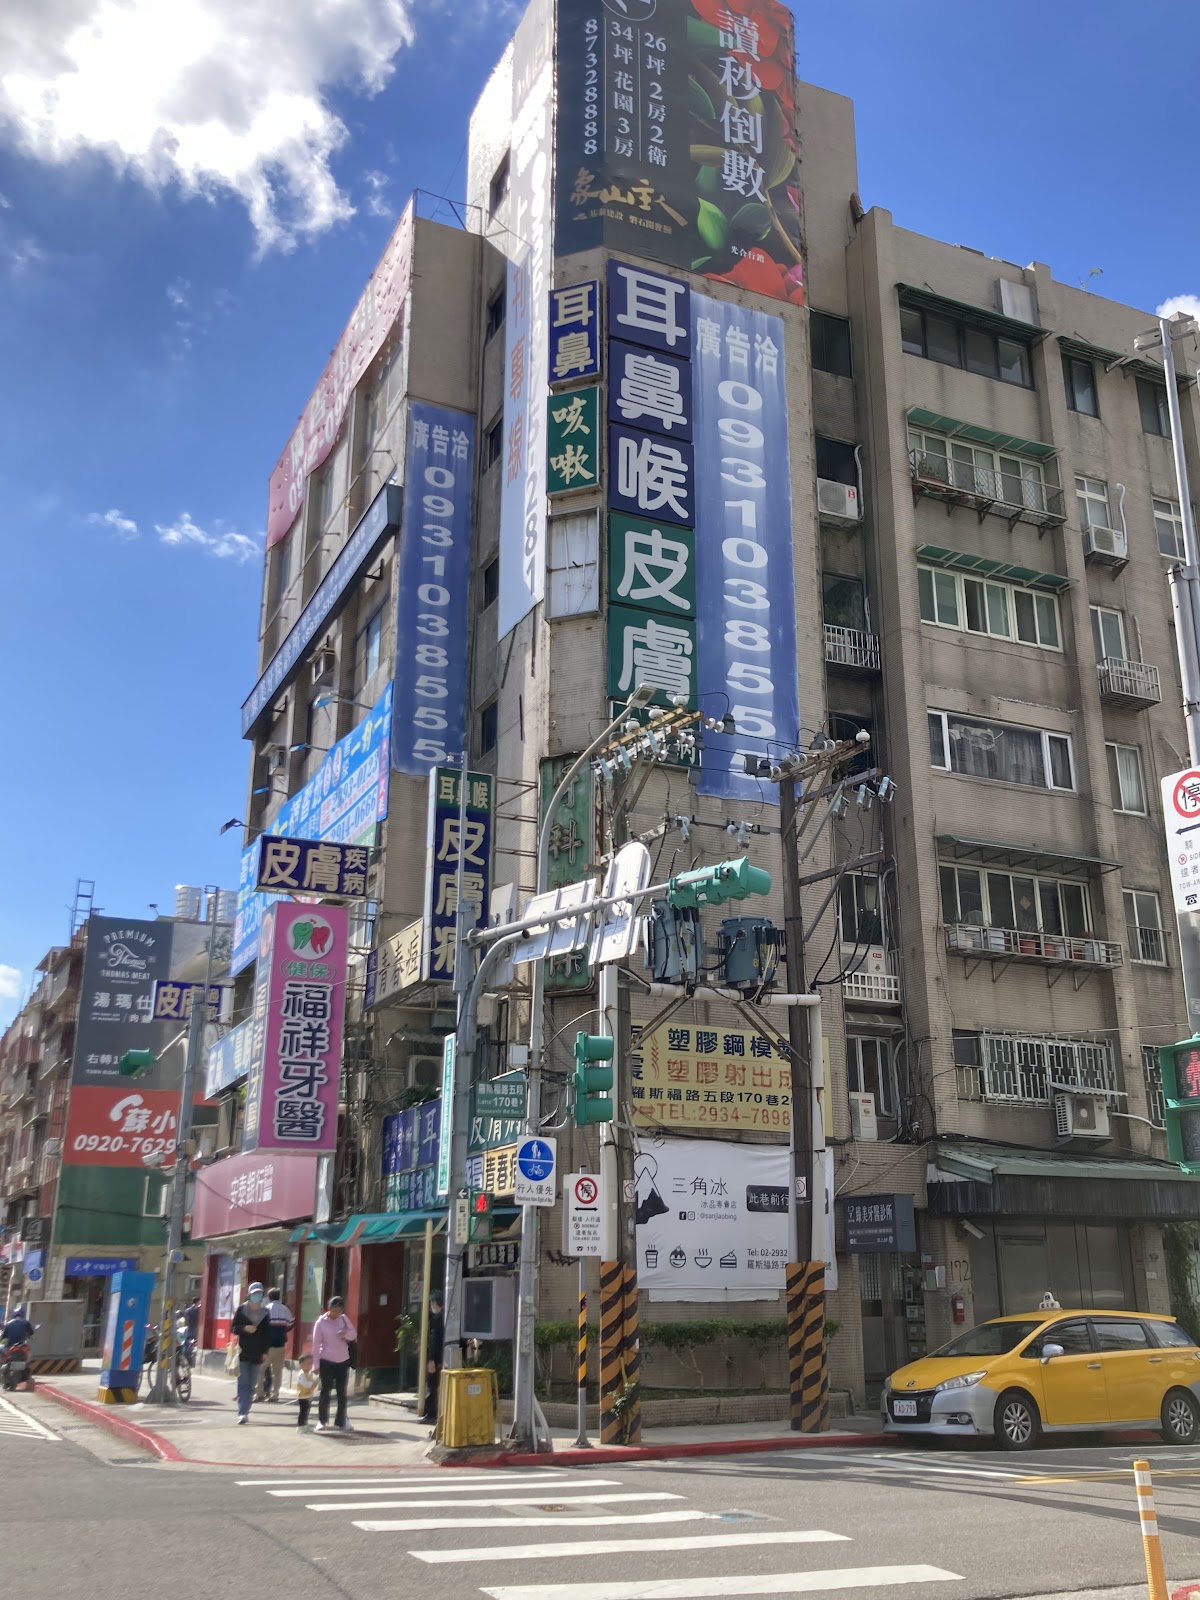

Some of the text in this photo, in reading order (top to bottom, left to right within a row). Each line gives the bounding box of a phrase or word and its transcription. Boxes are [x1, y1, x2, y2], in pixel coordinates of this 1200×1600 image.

[584, 18, 598, 155] 87328888
[717, 8, 767, 203] 讀秒倒數
[731, 245, 765, 264] 光合行銷
[553, 283, 594, 377] 耳鼻
[696, 316, 779, 373] 廣告洽
[412, 418, 469, 461] 廣告洽
[550, 395, 594, 485] 咳嗽
[412, 465, 456, 762] 0931038555
[439, 775, 488, 809] 耳鼻喉
[1181, 782, 1200, 810] 停
[261, 839, 342, 893] 皮膚
[343, 847, 367, 896] 疾病
[103, 929, 156, 947] PREMIUM
[107, 942, 147, 970] Thomas
[379, 929, 420, 994] 青春痘
[101, 969, 150, 980] THOMAS MEAT
[93, 991, 154, 1010] 湯瑪仕
[275, 980, 333, 1142] 福祥牙醫
[478, 1083, 524, 1095] 羅斯福路五段
[494, 1097, 519, 1107] 170巷
[517, 1183, 553, 1195] 行人優先
[581, 1183, 593, 1198] 停
[672, 1176, 728, 1196] 三角冰
[700, 1200, 737, 1209] 冰品專賣店
[748, 1192, 789, 1206] 此巷前行
[747, 1248, 759, 1257] Tel:
[950, 1260, 971, 1282] 172
